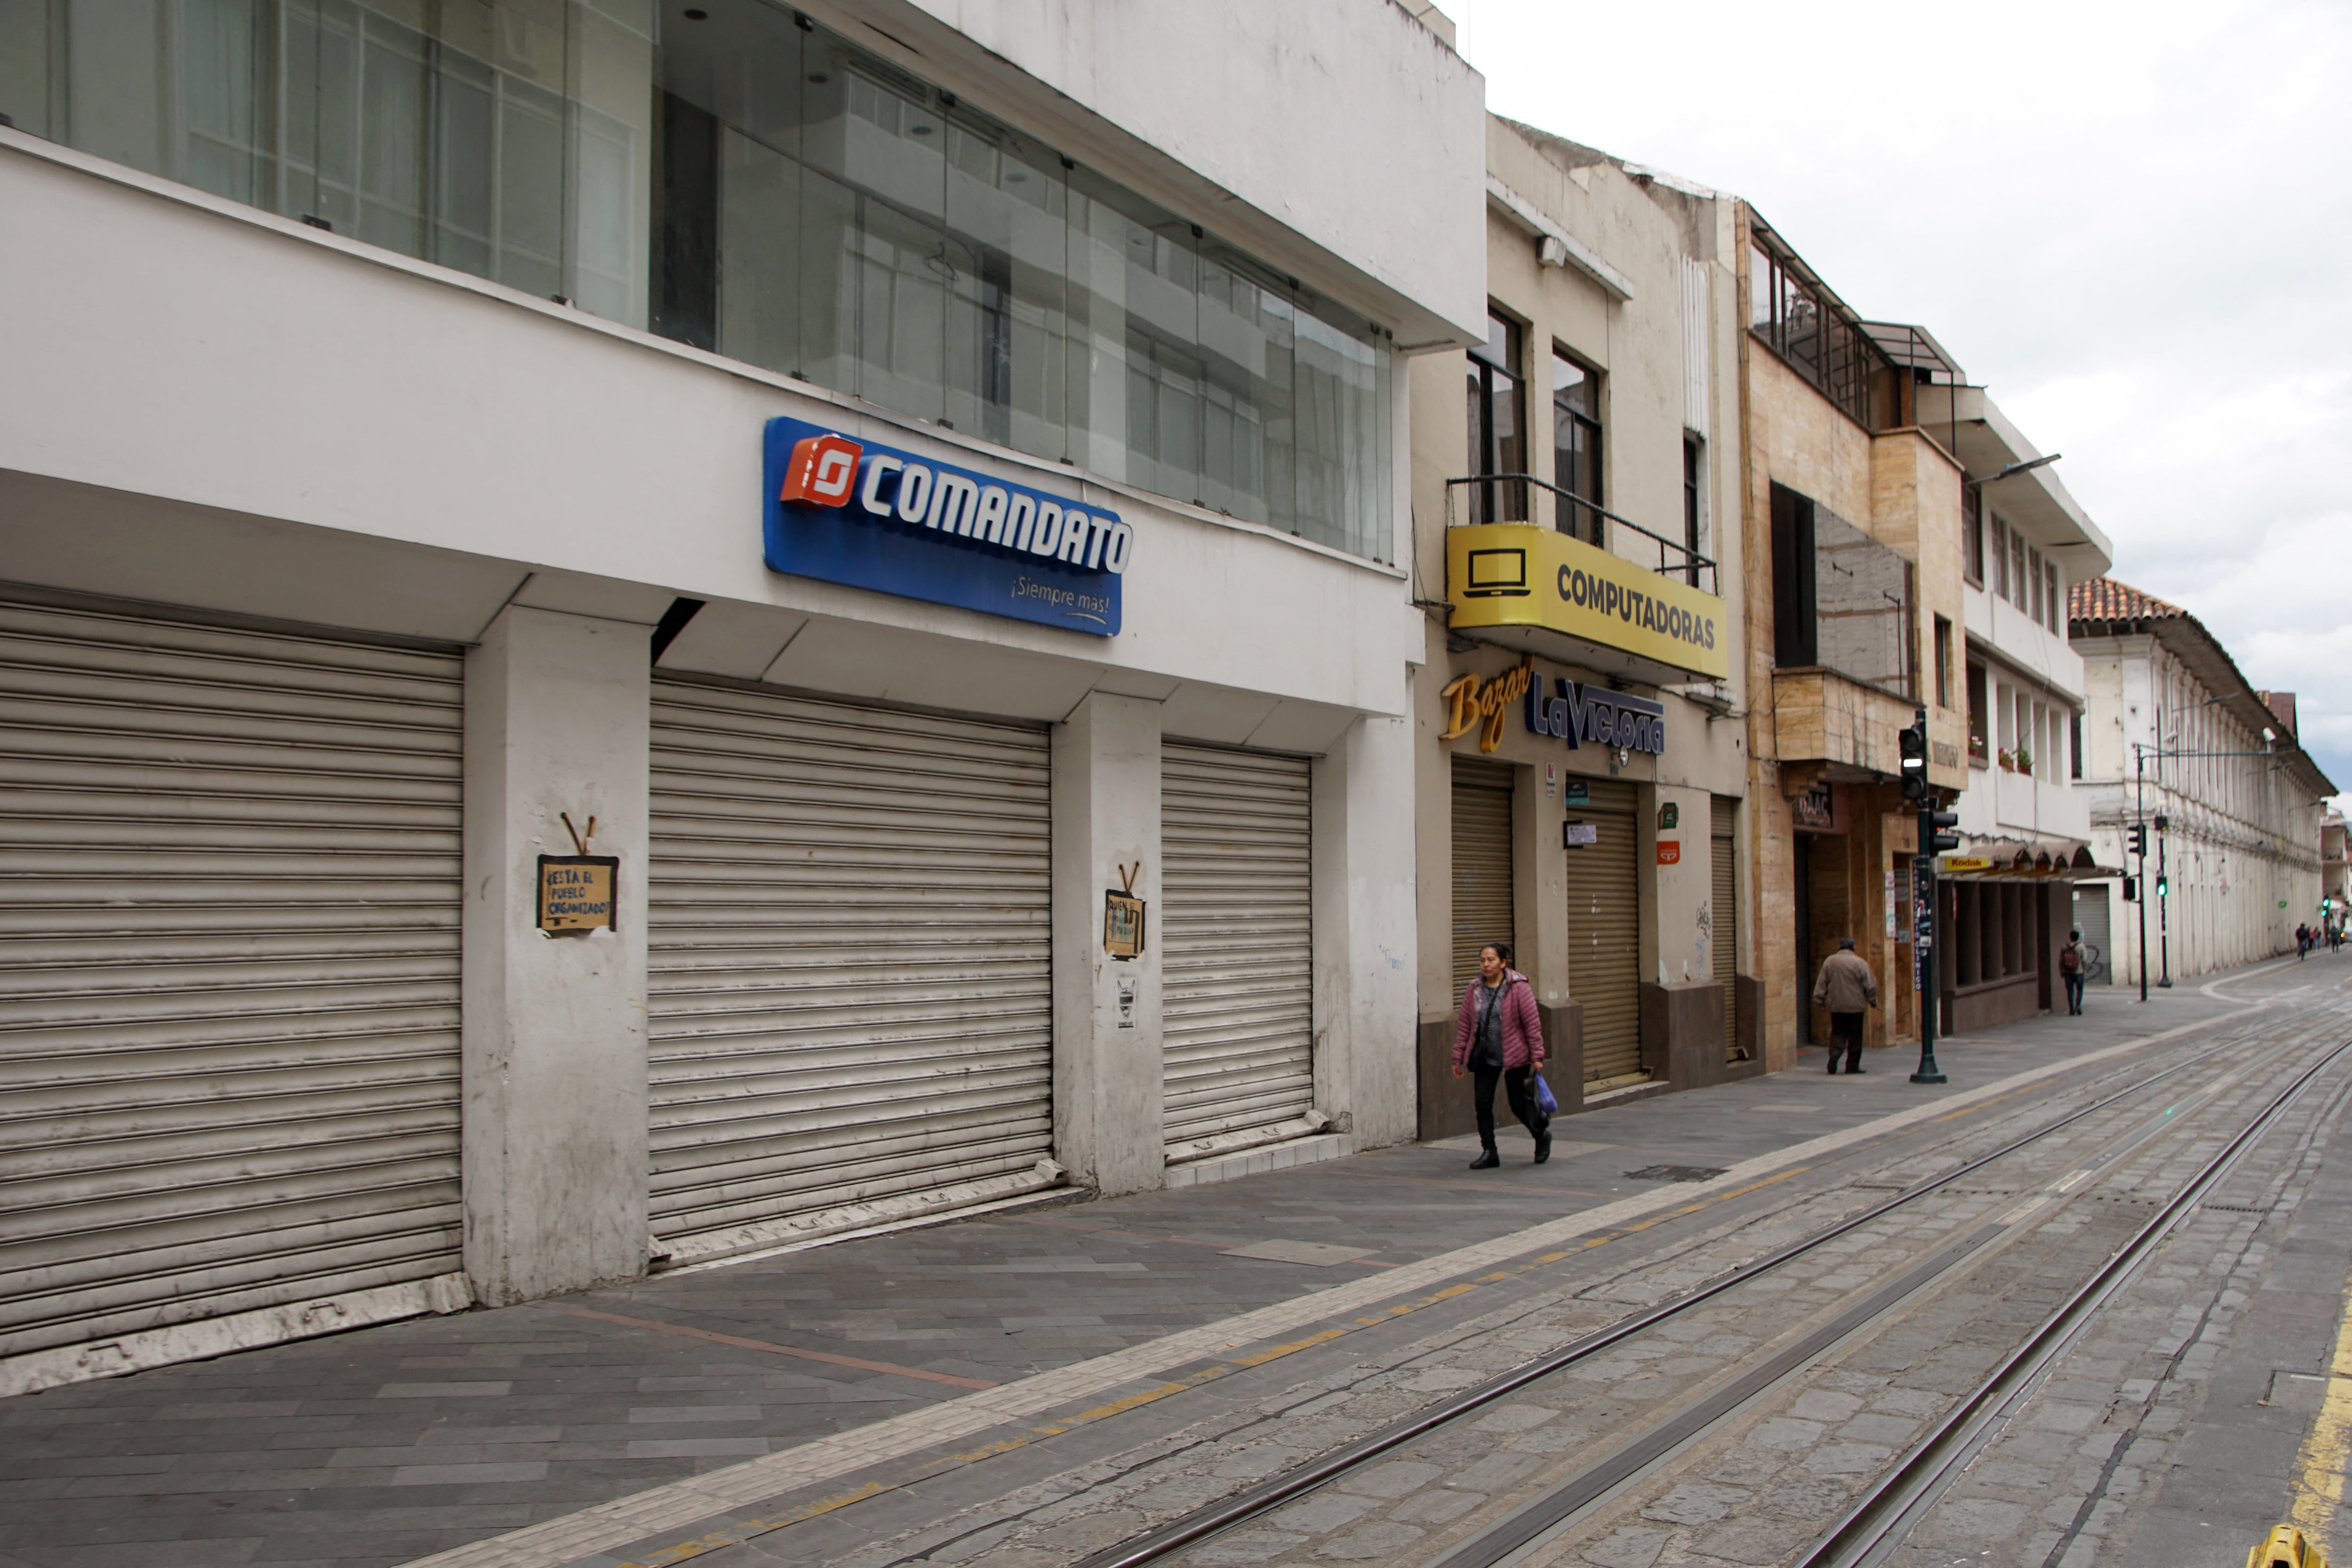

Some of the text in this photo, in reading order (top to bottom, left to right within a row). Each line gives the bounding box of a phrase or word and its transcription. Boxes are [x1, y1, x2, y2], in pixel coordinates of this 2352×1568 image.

[861, 454, 1134, 574] COMANDATO
[1011, 576, 1110, 613] ¡Siempre más!
[1557, 564, 1715, 650] COMPUTADORAS
[1438, 654, 1534, 753] Bazar
[1951, 858, 1982, 867] Kodak
[583, 871, 594, 884] EL
[552, 886, 586, 899] PUEBLO
[549, 901, 611, 916] ORGANIZADO?
